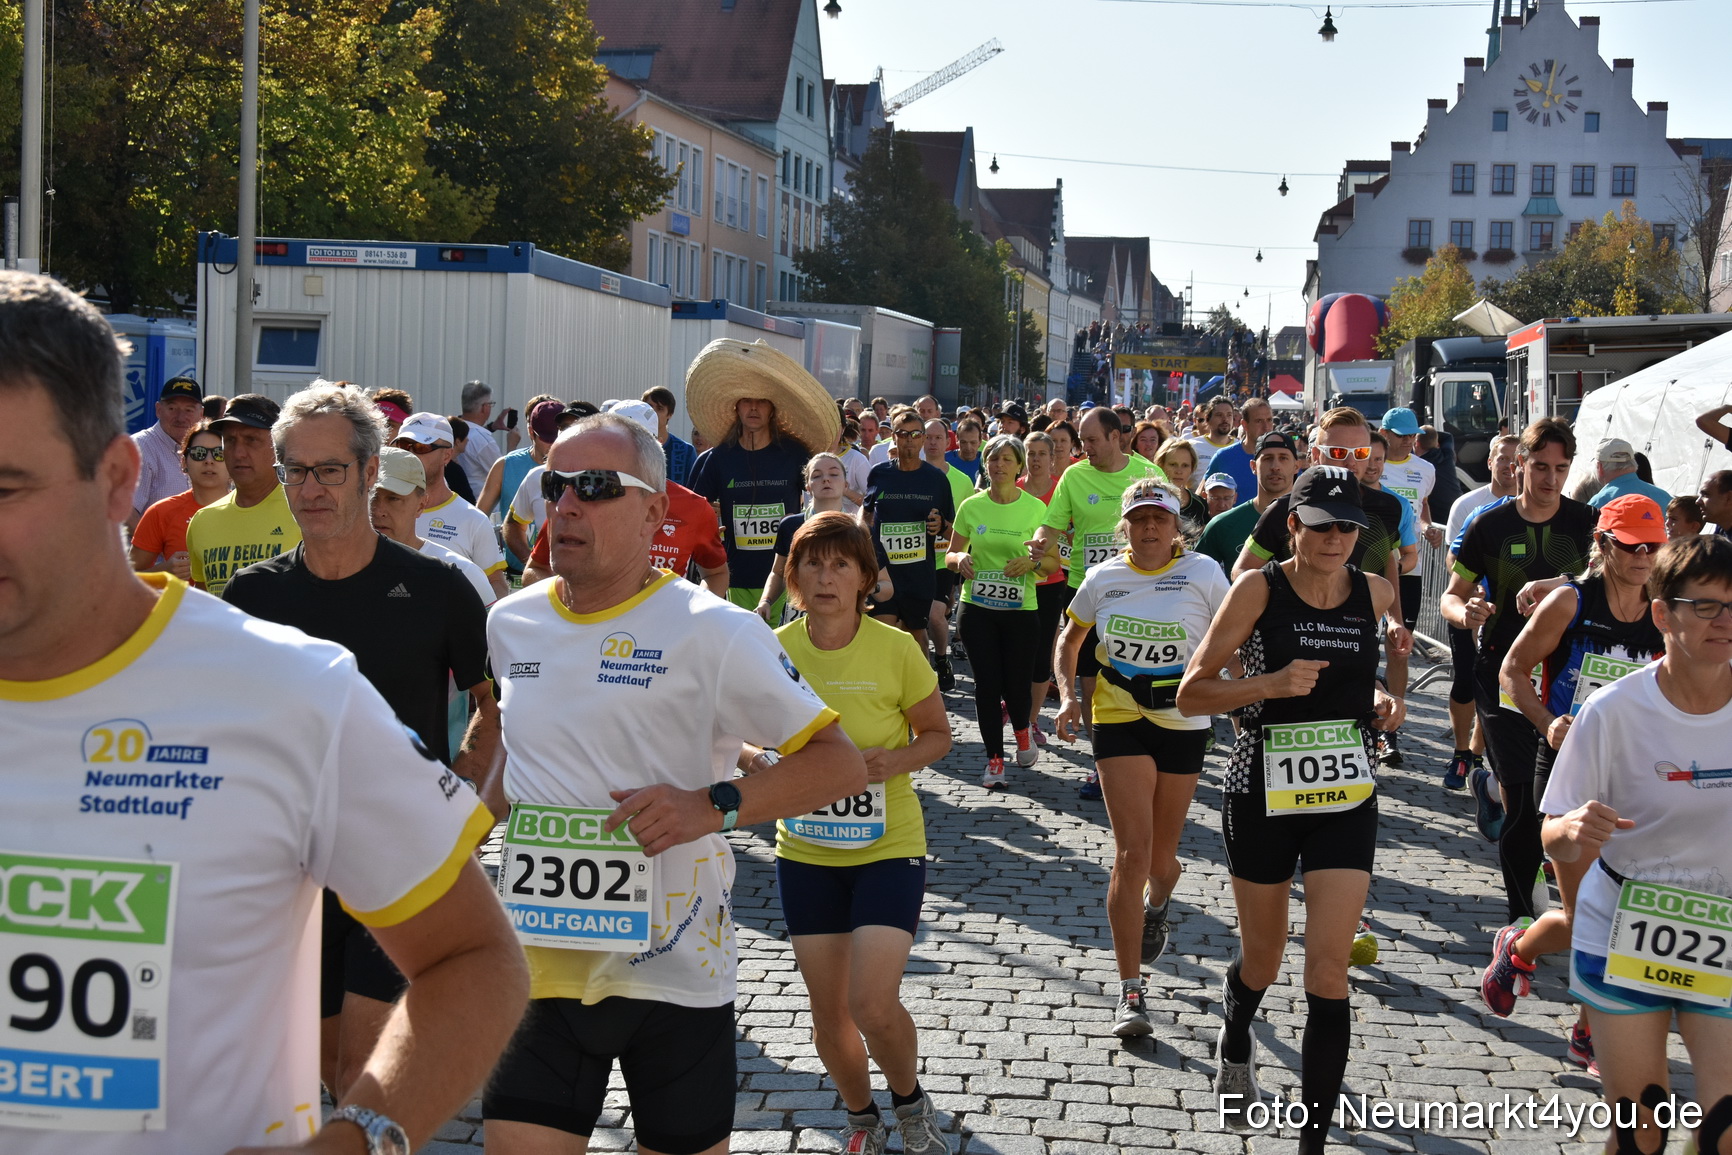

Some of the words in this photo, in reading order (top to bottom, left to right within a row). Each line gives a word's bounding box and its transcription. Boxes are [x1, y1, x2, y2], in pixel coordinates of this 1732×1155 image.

[1151, 358, 1190, 368] START
[734, 480, 755, 488] GOSSEN
[756, 479, 788, 487] METRAWATT
[904, 493, 934, 502] METRAWATT
[737, 506, 780, 517] BOCK
[431, 519, 443, 528] 20
[740, 520, 780, 535] 1186
[884, 525, 921, 534] BOCK
[428, 528, 459, 537] Neumarkter
[428, 533, 452, 541] Stadtlauf
[650, 543, 679, 554] aturn
[886, 536, 921, 550] 1183
[204, 546, 231, 565] BMW
[233, 543, 282, 561] BERLIN
[977, 583, 1018, 600] 2238
[984, 599, 1009, 607] PETRA
[1112, 617, 1181, 639] BOCK
[1293, 622, 1315, 632] LLC
[1316, 622, 1361, 635] Marathon
[603, 638, 634, 659] 20
[634, 650, 660, 658] JAHRE
[1113, 639, 1178, 664] 2749
[1299, 636, 1360, 652] Regensburg
[510, 662, 541, 675] BOCK
[600, 659, 668, 675] Neumarkter
[597, 673, 653, 689] Stadtlauf
[1273, 724, 1356, 749] BOCK
[89, 727, 145, 763] 20
[151, 746, 204, 763] JAHRE
[1278, 752, 1360, 785] 1035
[84, 770, 224, 791] Neumarkter
[1294, 790, 1348, 805] PETRA
[79, 794, 195, 820] Stadtlauf
[794, 823, 872, 839] GERLINDE
[512, 853, 631, 902] 2302
[638, 864, 646, 872] D
[1628, 885, 1732, 925] BOCK
[506, 908, 633, 934] WOLFGANG
[655, 915, 693, 955] September
[690, 895, 703, 918] 2019
[1630, 920, 1727, 968] 1022
[1643, 965, 1695, 988] LORE
[9, 952, 131, 1038] 90
[141, 967, 154, 983] D
